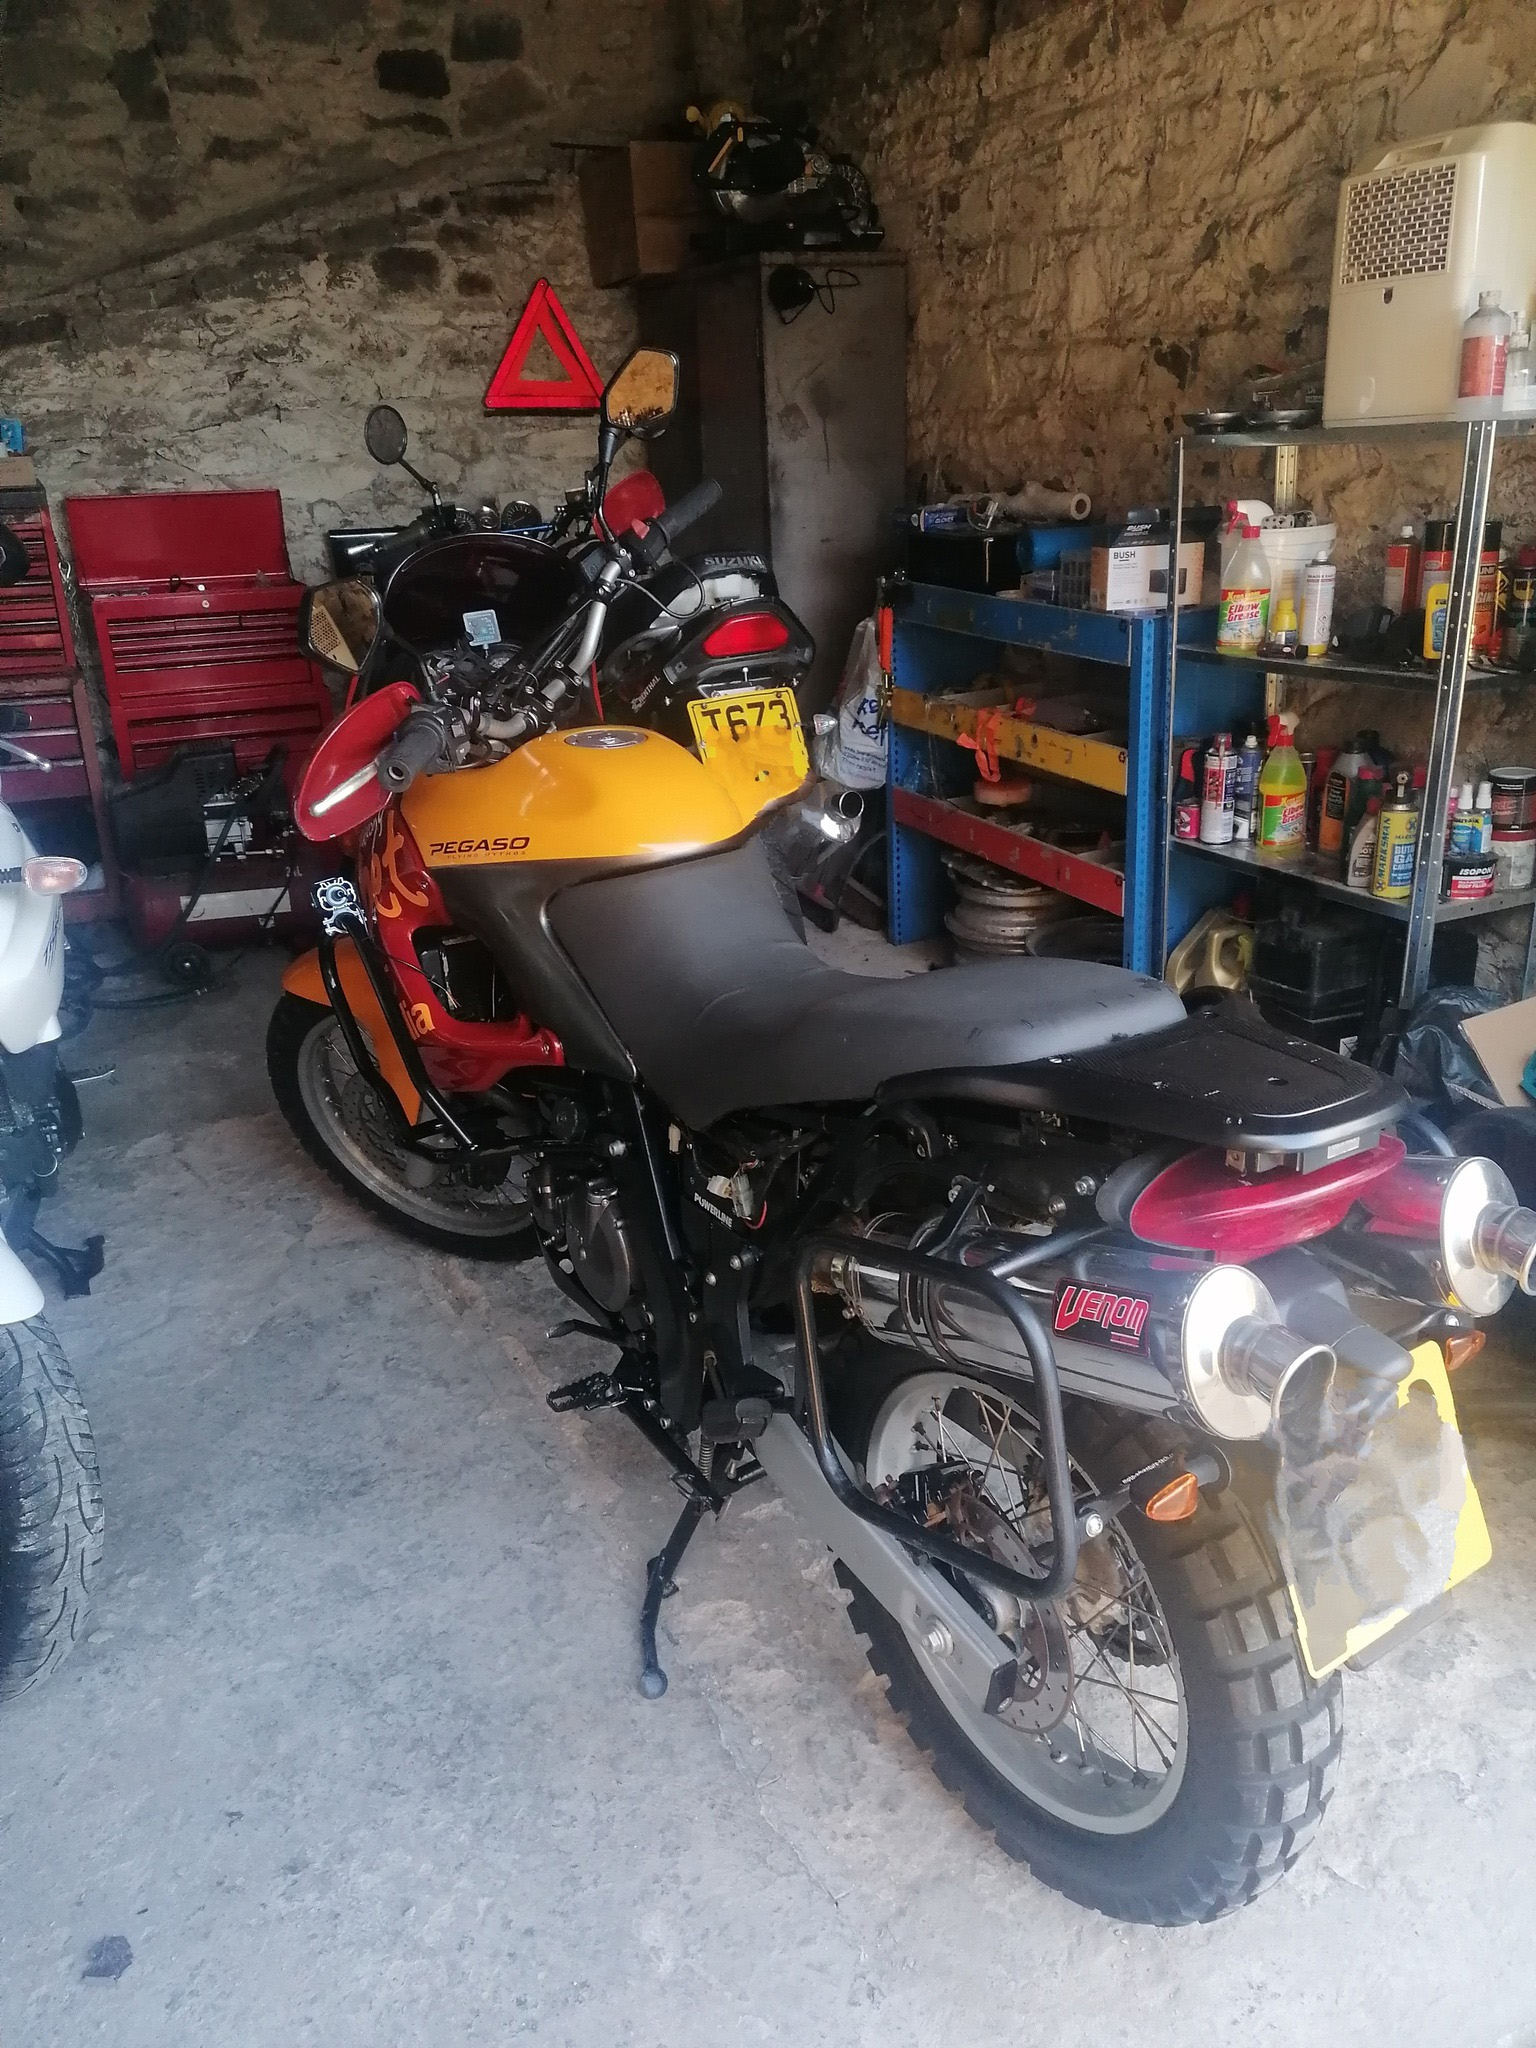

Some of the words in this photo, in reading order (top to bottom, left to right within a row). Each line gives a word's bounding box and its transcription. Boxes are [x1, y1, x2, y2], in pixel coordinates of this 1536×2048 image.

[1113, 551, 1136, 559] BUSH
[704, 555, 763, 567] SUZUKI
[1480, 565, 1495, 575] UNK
[1228, 603, 1260, 614] Elbow
[1227, 611, 1260, 622] Grease
[429, 836, 531, 857] PEGASO
[1377, 816, 1392, 878] MARKSMAN
[1393, 854, 1413, 863] GA
[694, 1191, 733, 1228] POWERLINE
[1054, 1285, 1150, 1337] VENOM
